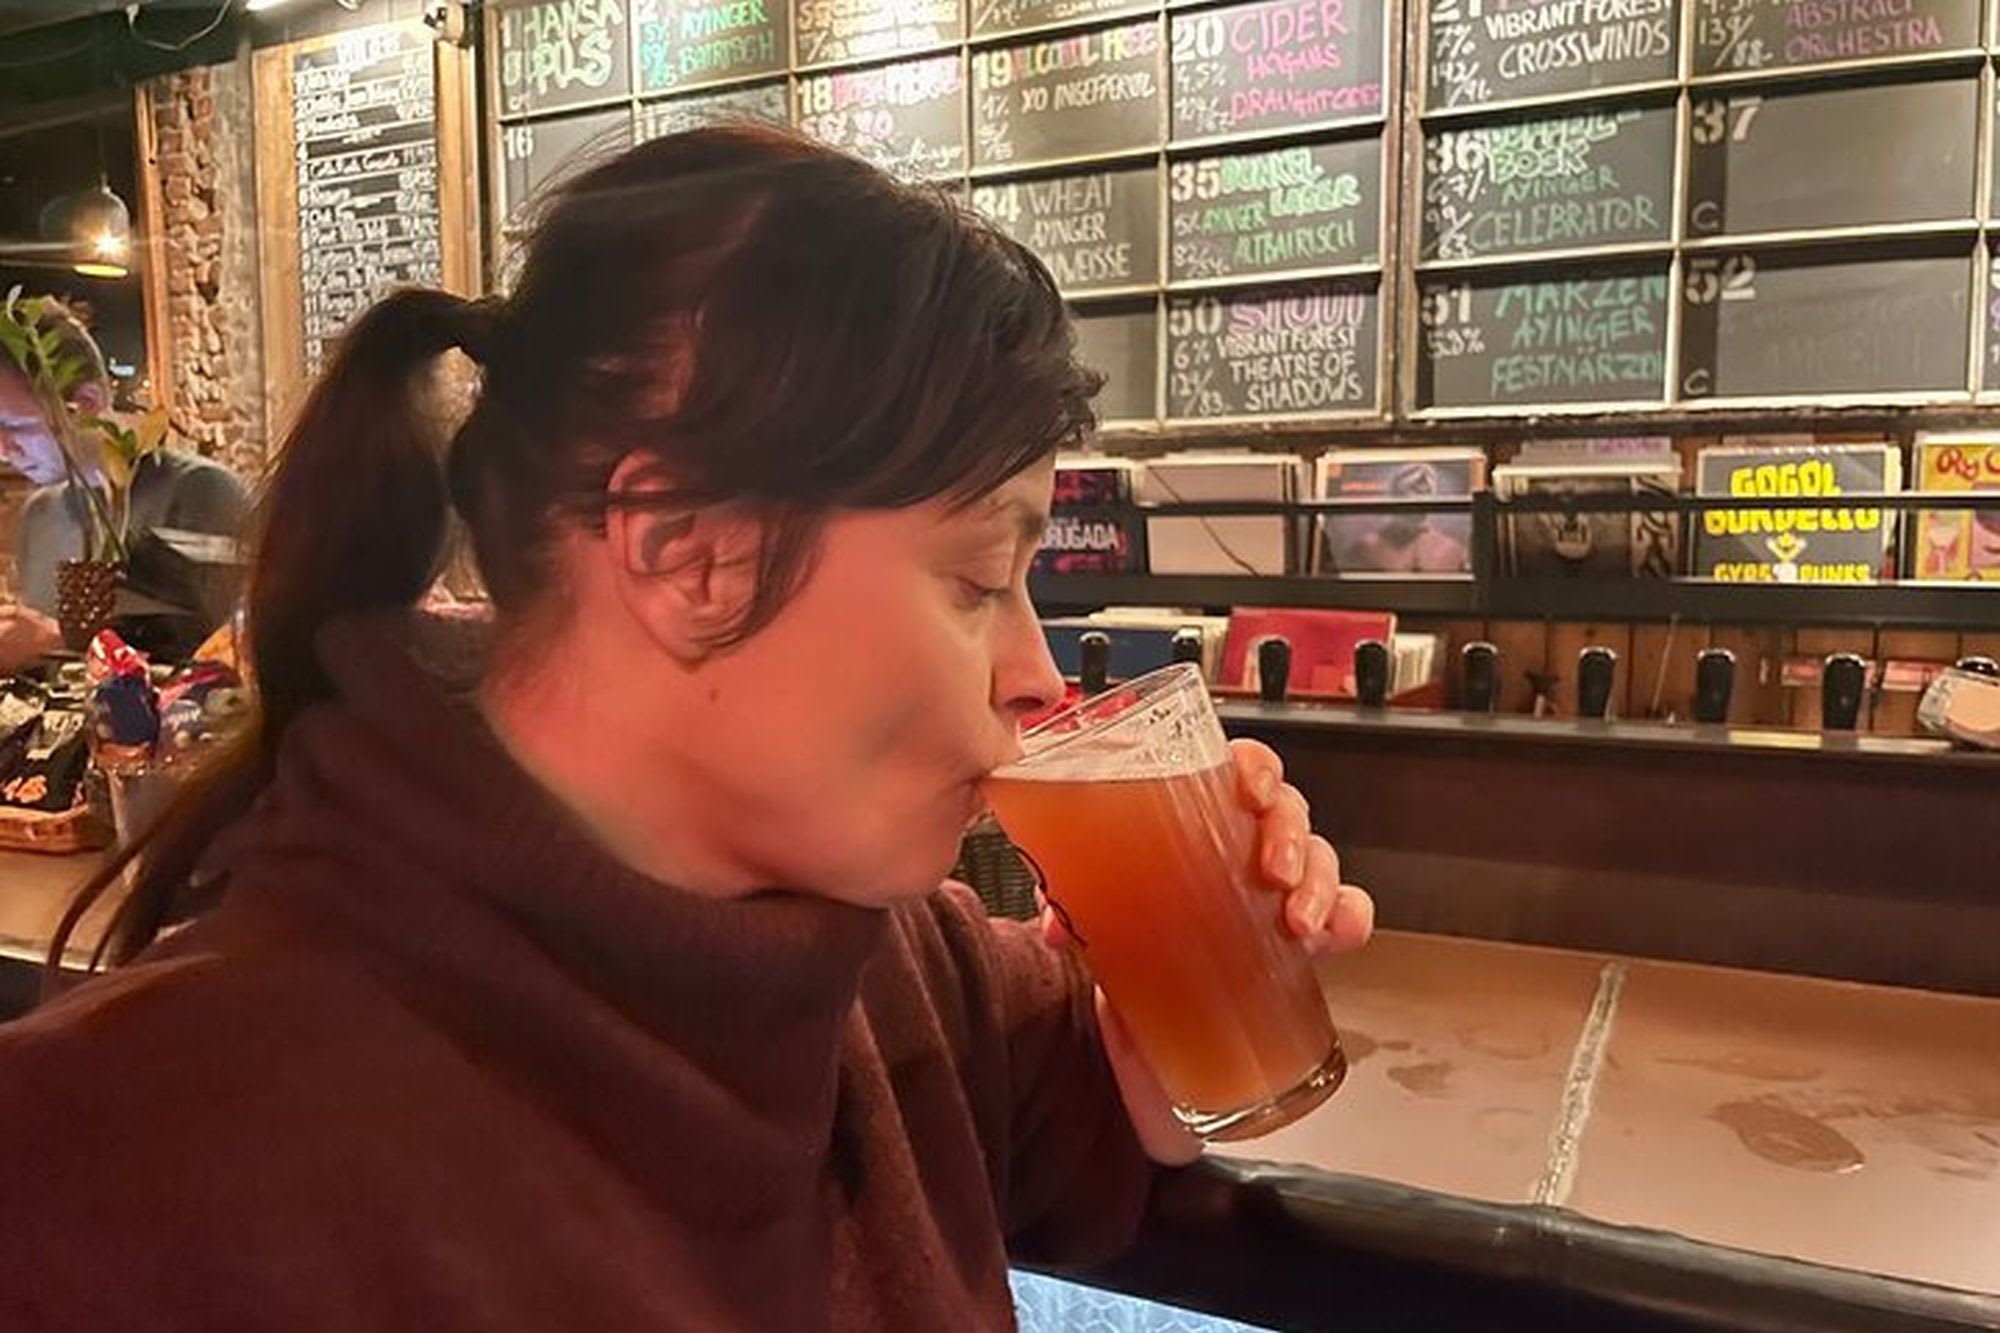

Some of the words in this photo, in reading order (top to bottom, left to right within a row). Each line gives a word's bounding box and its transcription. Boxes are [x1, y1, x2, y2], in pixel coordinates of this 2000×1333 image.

[525, 0, 623, 44] HANSA
[1171, 15, 1225, 64] 20
[1230, 0, 1349, 56] CIDER
[1485, 5, 1579, 41] VIBRANT
[1784, 16, 1943, 63] ORCHESTRA
[972, 49, 1014, 90] 19
[1498, 18, 1671, 79] CROSSWINDS
[797, 77, 833, 115] 18
[1692, 97, 1761, 145] 37
[1025, 173, 1113, 216] WHEAT
[1170, 159, 1222, 202] 35
[1470, 194, 1661, 251] CELEBRATOR
[1685, 254, 1755, 303] 52
[1169, 298, 1223, 336] 50
[1511, 306, 1655, 350] AYINGER
[1228, 352, 1321, 385] THEATRE
[1322, 350, 1356, 377] OF
[1244, 371, 1363, 412] SHADOWS
[1731, 459, 1842, 498] GOGOL
